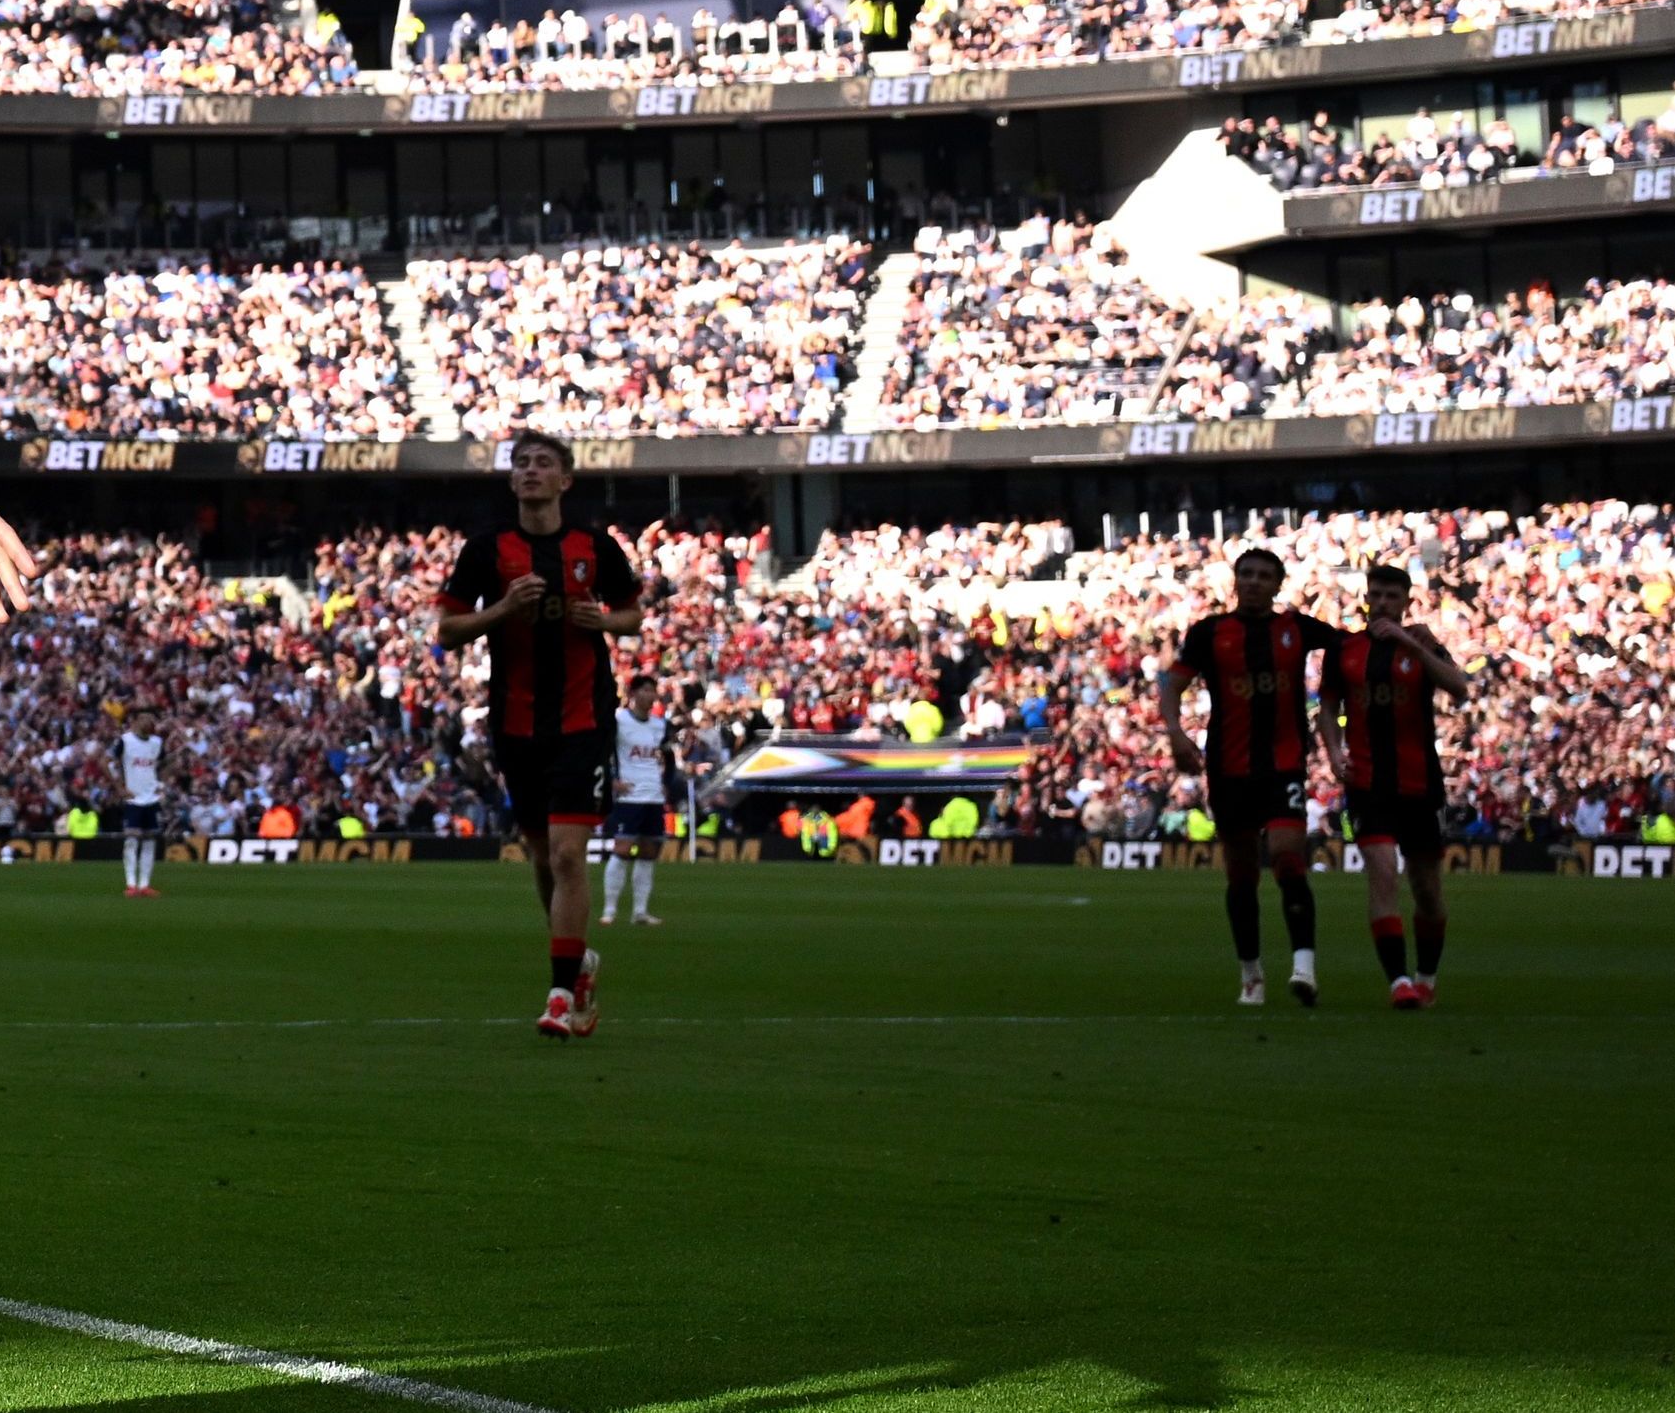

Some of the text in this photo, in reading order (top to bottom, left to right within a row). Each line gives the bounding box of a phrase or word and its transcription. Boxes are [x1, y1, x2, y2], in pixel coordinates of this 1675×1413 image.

[1492, 13, 1634, 58] BETMGM
[1180, 47, 1322, 87] BETMGM
[636, 82, 774, 117] BETMGM
[869, 69, 1008, 107] BETMGM
[124, 94, 250, 125] BETMGM
[410, 91, 544, 122] BETMGM
[1360, 186, 1501, 224] BETMGM
[1130, 419, 1276, 455] BETMGM
[1374, 409, 1516, 446] BETMGM
[47, 441, 175, 471] BETMGM
[264, 442, 399, 471] BETMGM
[807, 432, 950, 465] BETMGM
